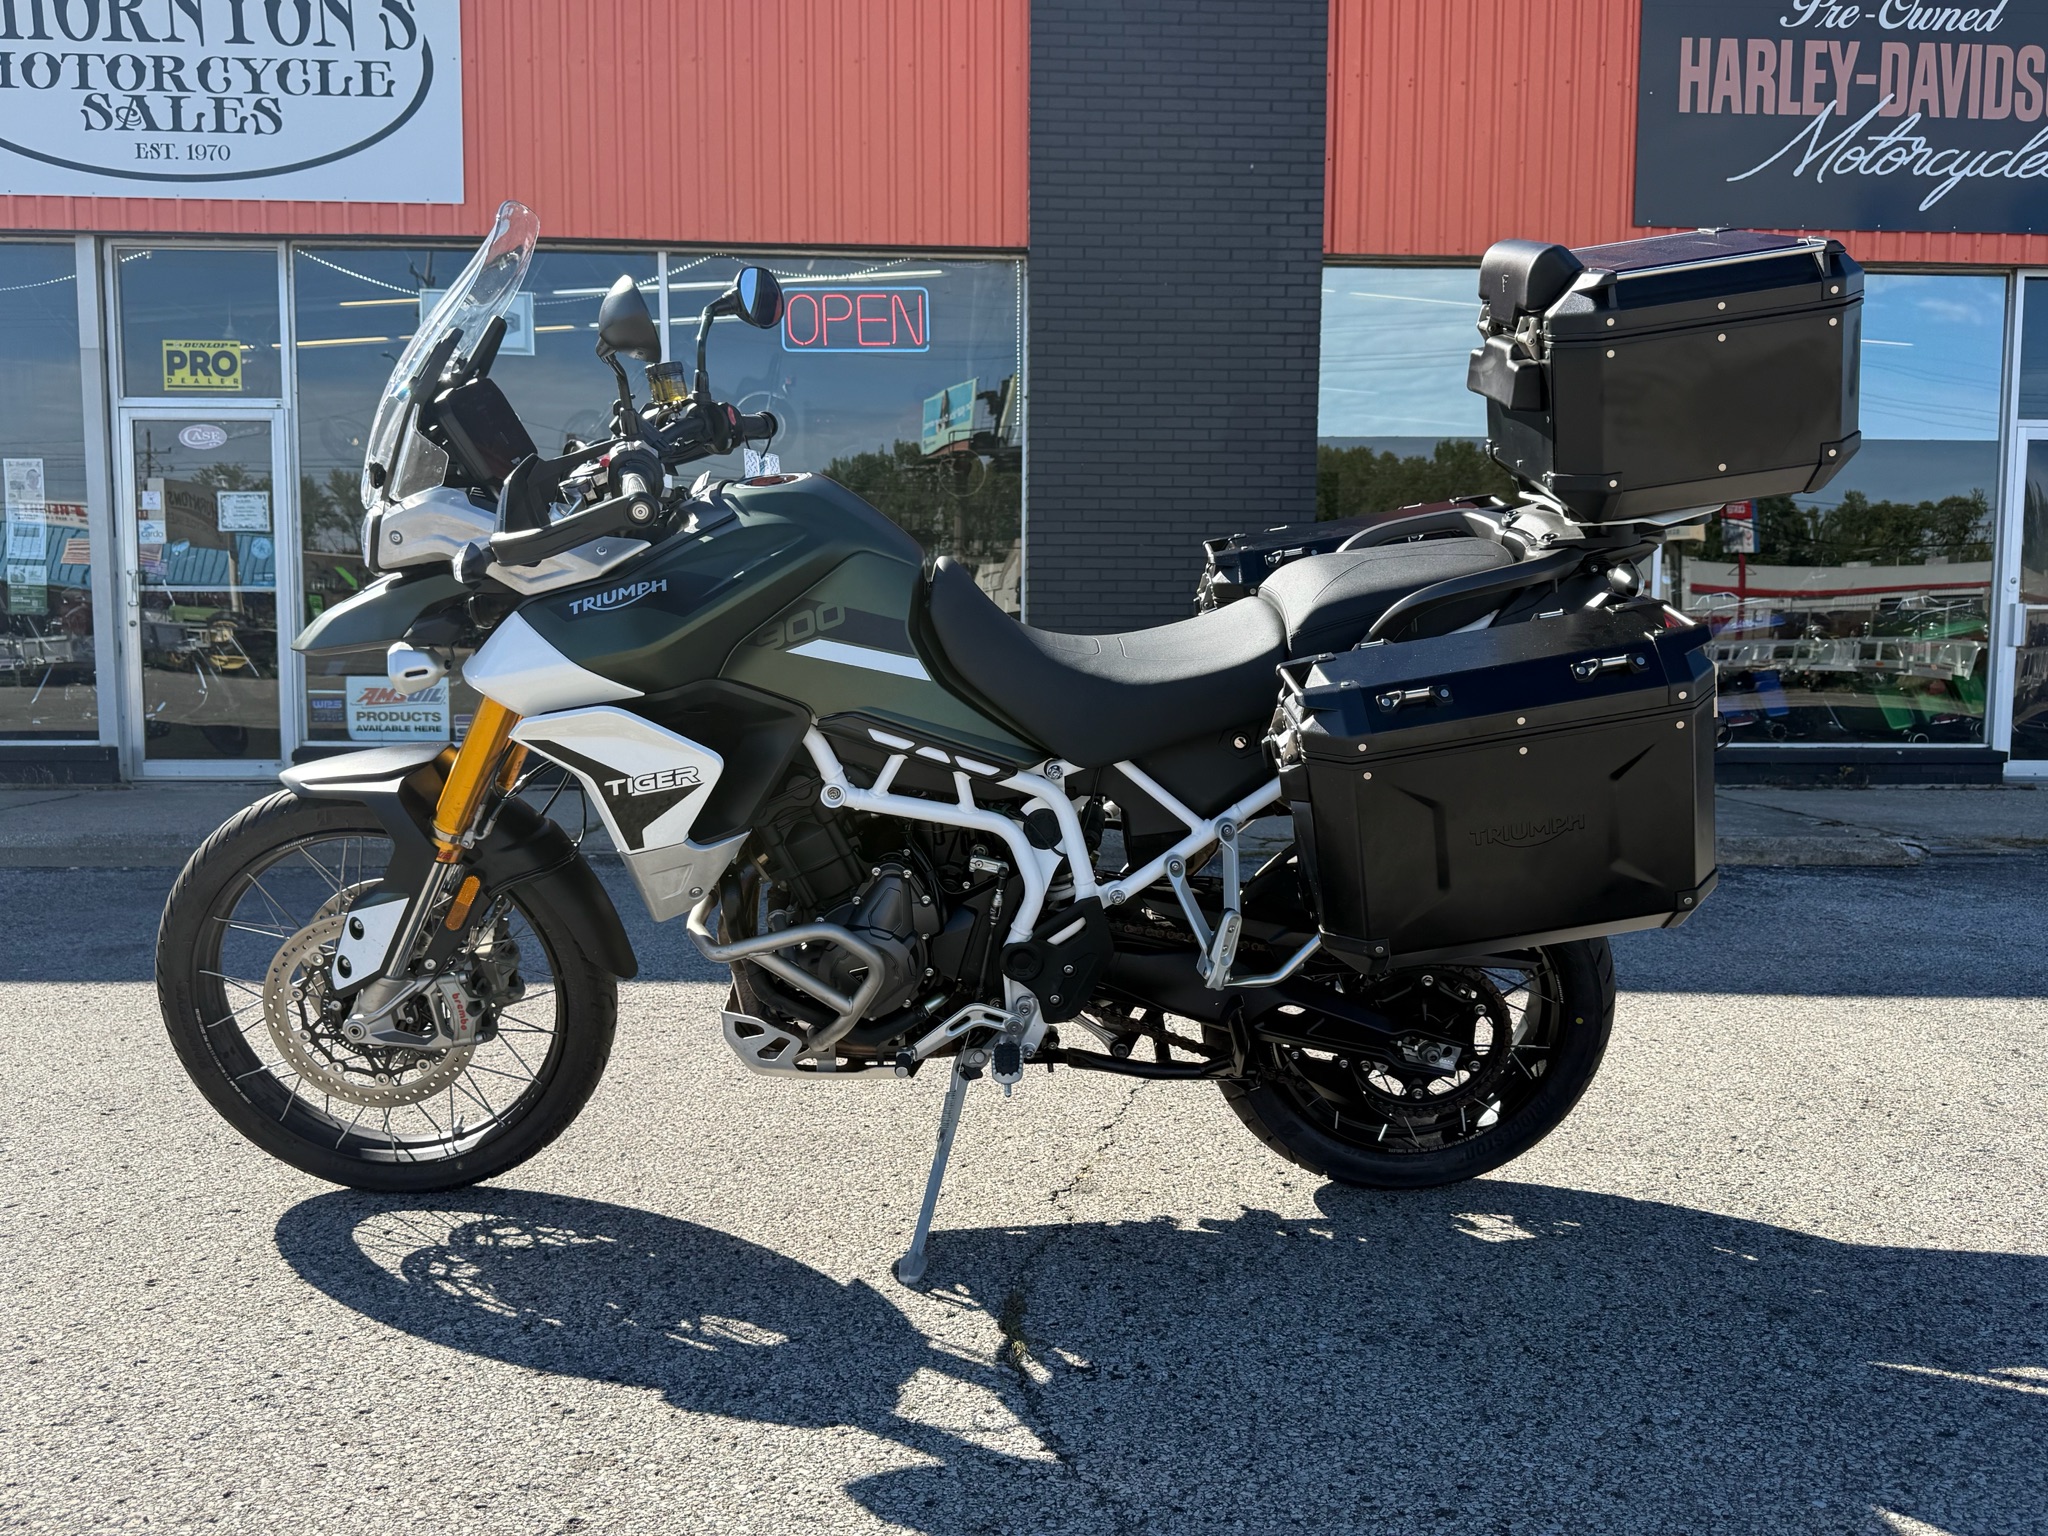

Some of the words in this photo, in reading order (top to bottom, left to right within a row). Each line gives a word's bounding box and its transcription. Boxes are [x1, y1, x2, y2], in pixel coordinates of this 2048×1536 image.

[1678, 37, 2048, 122] HARLEY-DAVIDS
[80, 92, 283, 136] SALES
[134, 142, 179, 161] EST.
[186, 143, 231, 162] 1970
[1726, 93, 2048, 211] Motorcycle
[787, 293, 923, 347] OPEN
[165, 350, 239, 378] PRO
[167, 377, 240, 385] DEALER
[569, 579, 668, 615] TRIUMPH
[757, 602, 846, 650] 900
[355, 724, 411, 733] AVAILABLE
[414, 725, 442, 733] HERE
[356, 711, 442, 722] PRODUCTS
[604, 766, 702, 797] TIGER
[1469, 813, 1586, 848] TRIUMPH
[452, 992, 468, 1031] brembo
